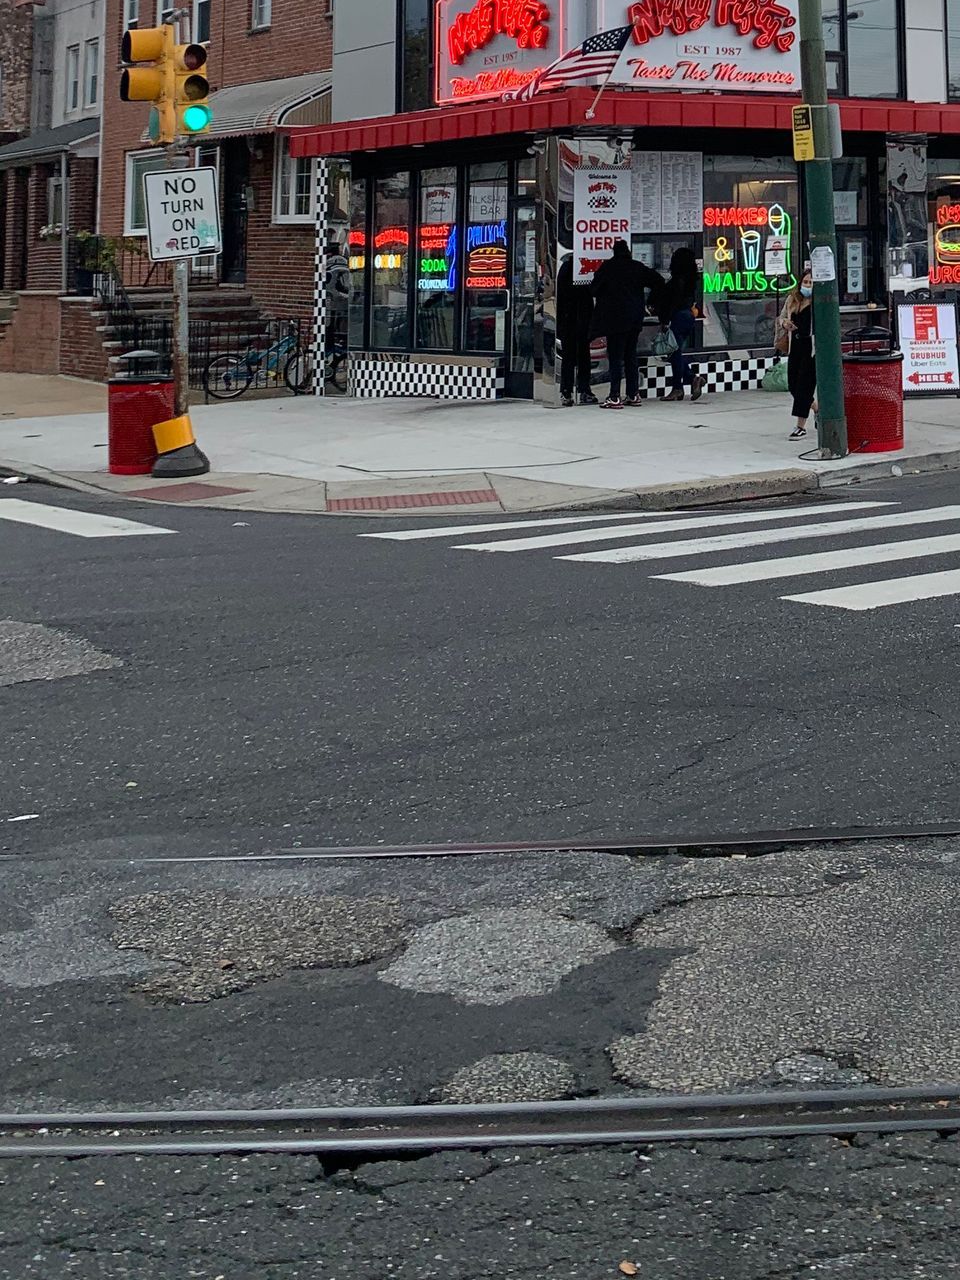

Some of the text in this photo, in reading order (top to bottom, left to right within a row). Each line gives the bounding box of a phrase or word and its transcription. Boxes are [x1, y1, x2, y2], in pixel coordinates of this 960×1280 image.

[484, 51, 518, 65] EST 1987
[684, 45, 743, 56] EST 1987
[627, 58, 796, 85] Taste The Memories
[164, 177, 196, 196] NO
[160, 197, 204, 215] TURN
[480, 205, 501, 215] BAR
[172, 217, 195, 232] ON
[704, 207, 768, 227] SHAKES
[576, 219, 629, 233] ORDER
[168, 235, 200, 251] RED
[714, 236, 732, 261] &
[421, 258, 448, 272] SODA
[703, 271, 768, 293] MALTS
[910, 351, 947, 360] GRUBHUB
[918, 374, 946, 382] HERE
